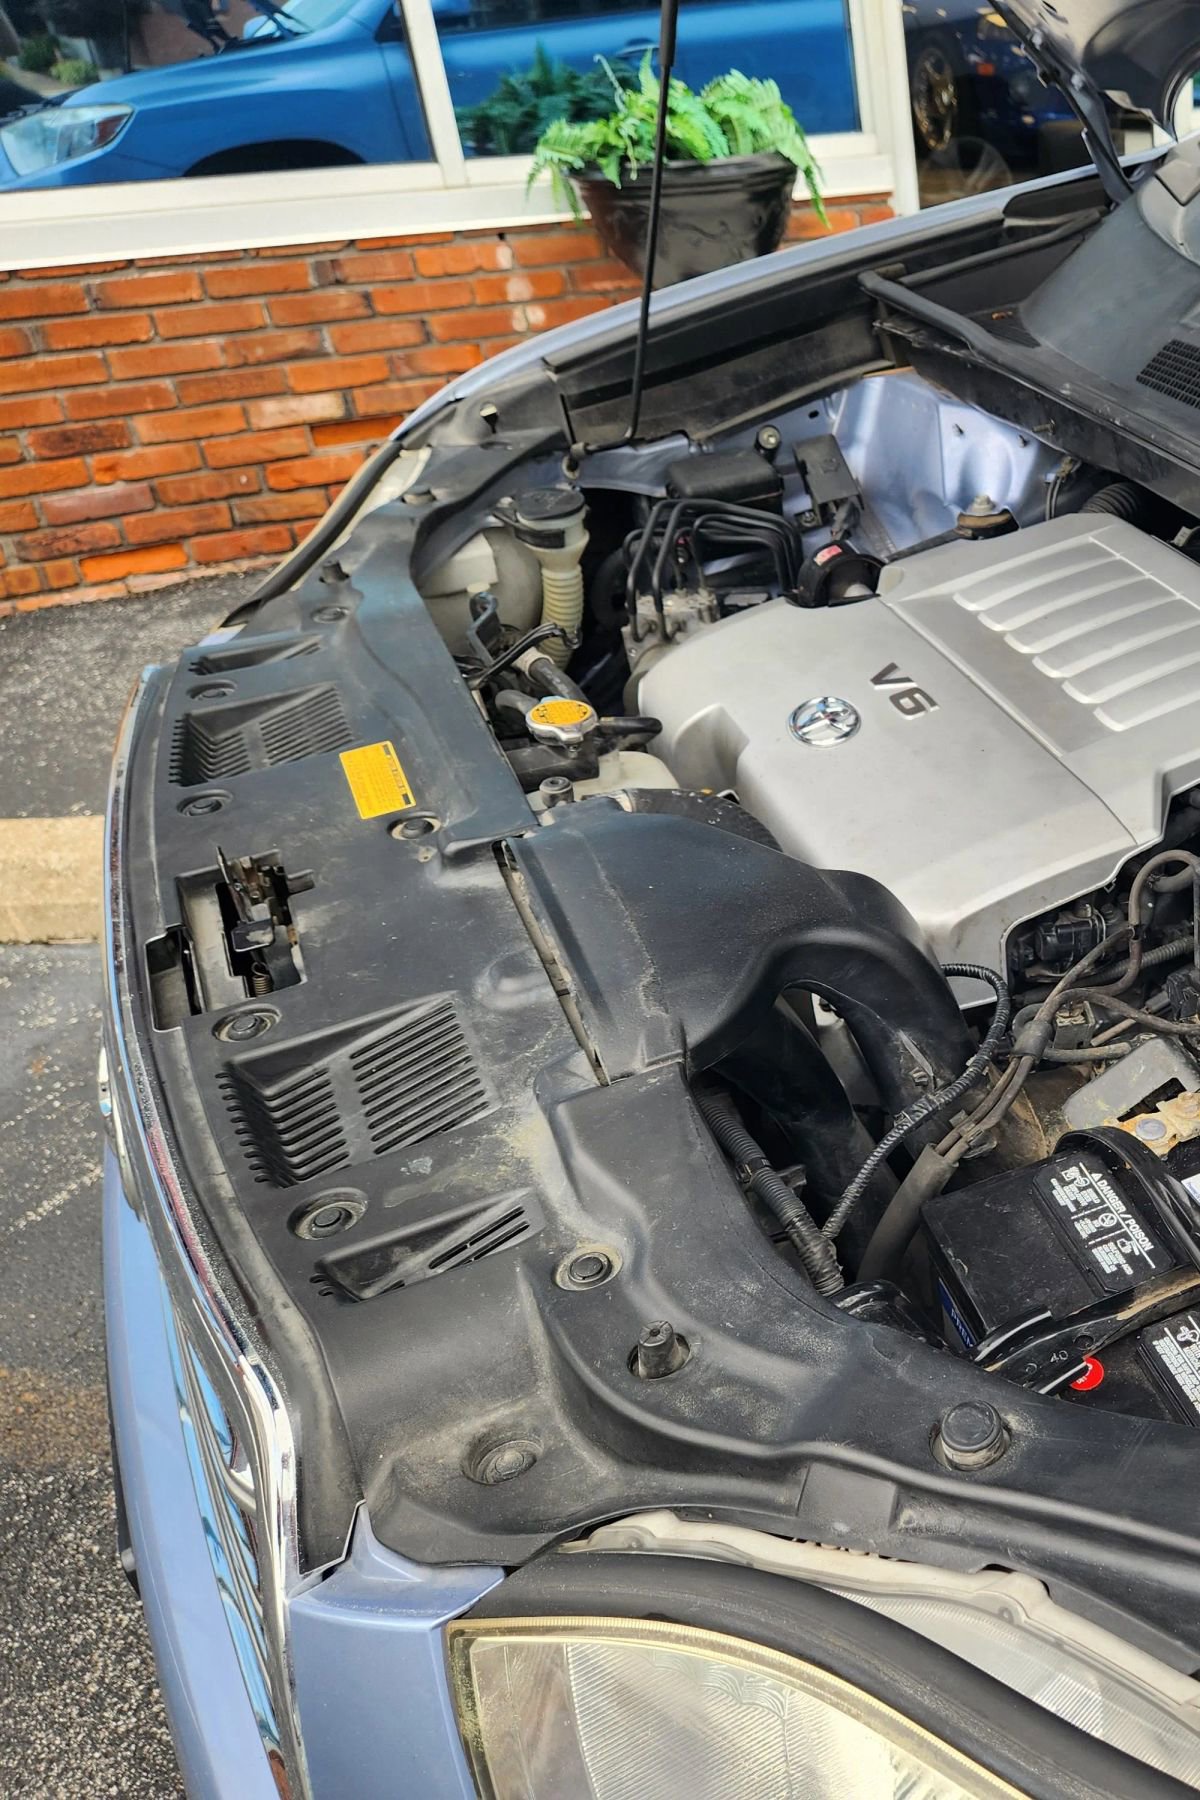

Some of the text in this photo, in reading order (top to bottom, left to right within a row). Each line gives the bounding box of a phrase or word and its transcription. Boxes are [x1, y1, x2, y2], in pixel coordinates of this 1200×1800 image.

[870, 661, 939, 720] V6
[1095, 1179, 1127, 1213] DANGER
[1124, 1218, 1154, 1250] POISON
